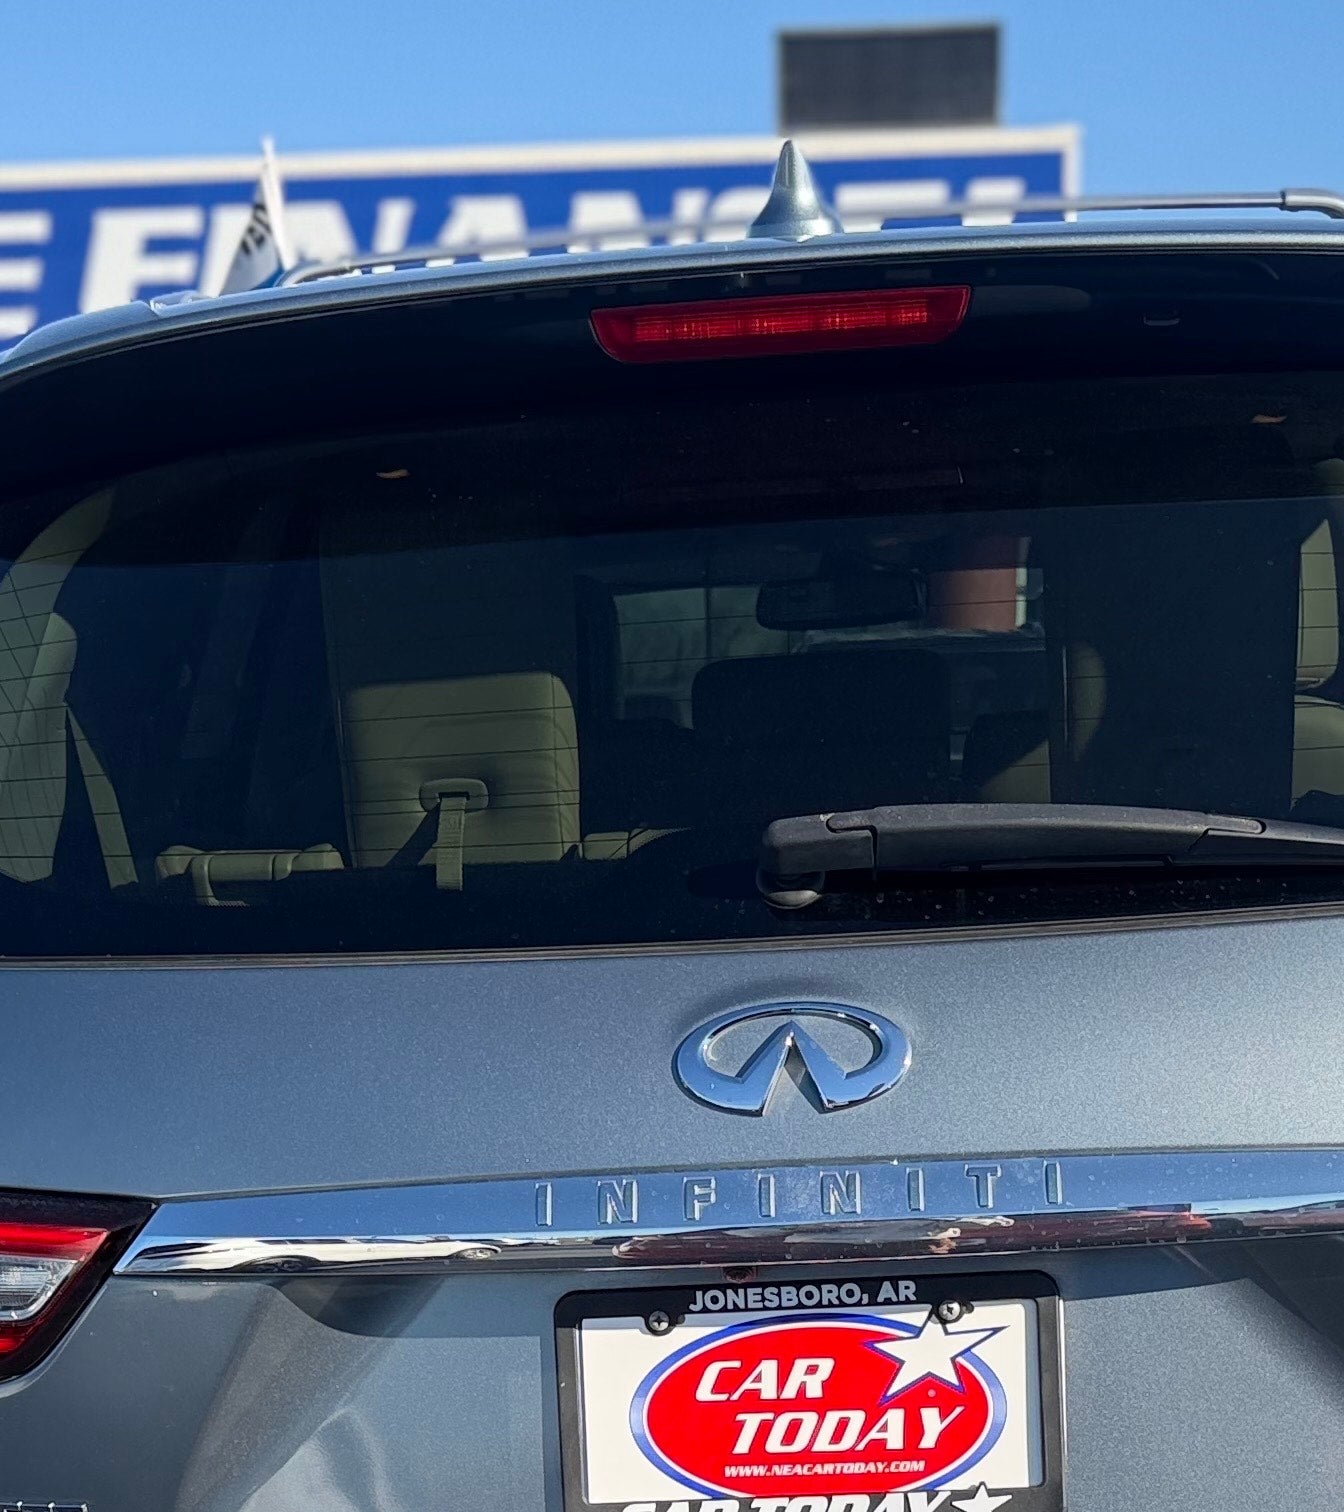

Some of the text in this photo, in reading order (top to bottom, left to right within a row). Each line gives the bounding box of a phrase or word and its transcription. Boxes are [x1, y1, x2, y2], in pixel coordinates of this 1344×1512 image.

[534, 1160, 1063, 1226] INFINITI
[688, 1280, 918, 1313] JONESBORO, AR
[694, 1357, 835, 1403] CAR
[731, 1404, 964, 1456] TODAY
[724, 1460, 925, 1478] WWW.NEACARTODAY.COM
